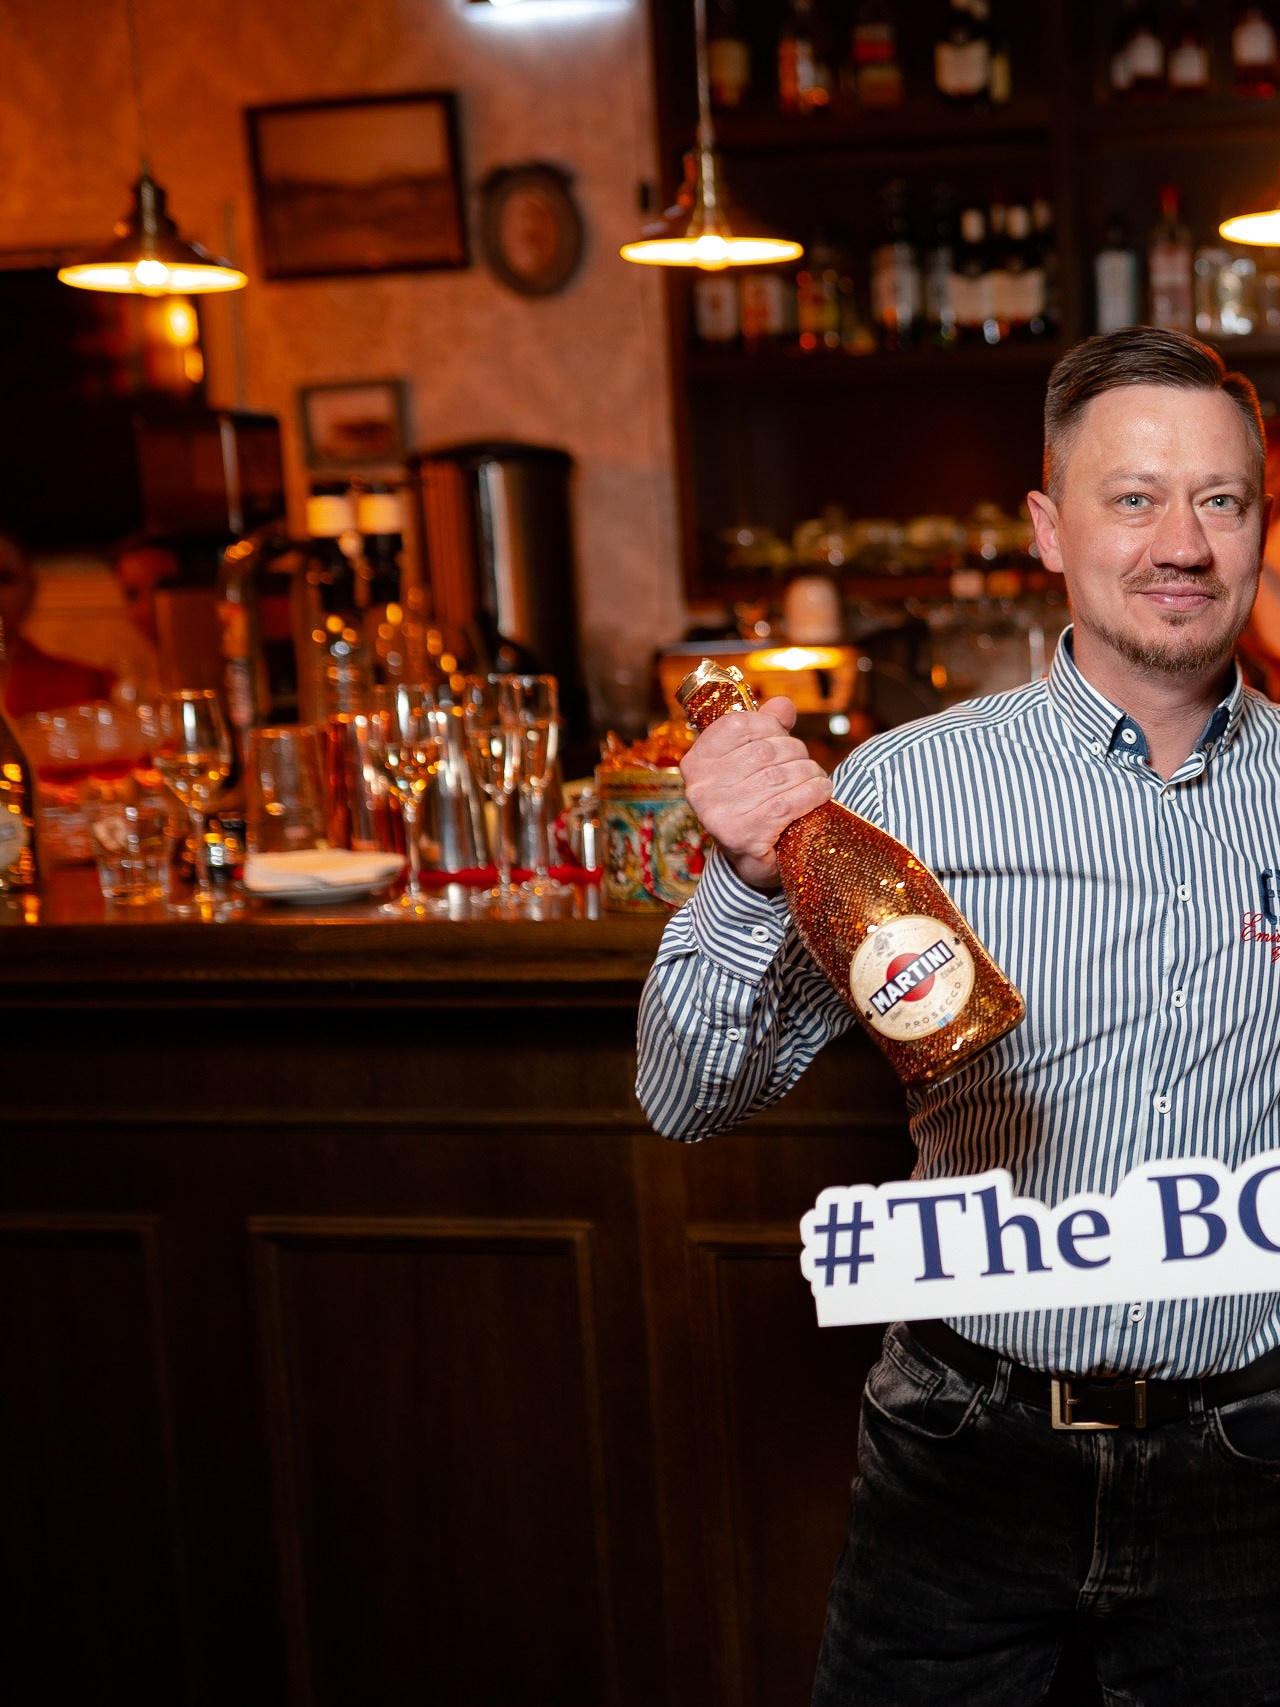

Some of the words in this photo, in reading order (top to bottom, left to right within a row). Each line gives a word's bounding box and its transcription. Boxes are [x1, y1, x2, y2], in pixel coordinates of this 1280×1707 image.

[870, 941, 954, 1015] MARTINI
[904, 981, 961, 1029] PROSECCO
[813, 1185, 1112, 1288] #The
